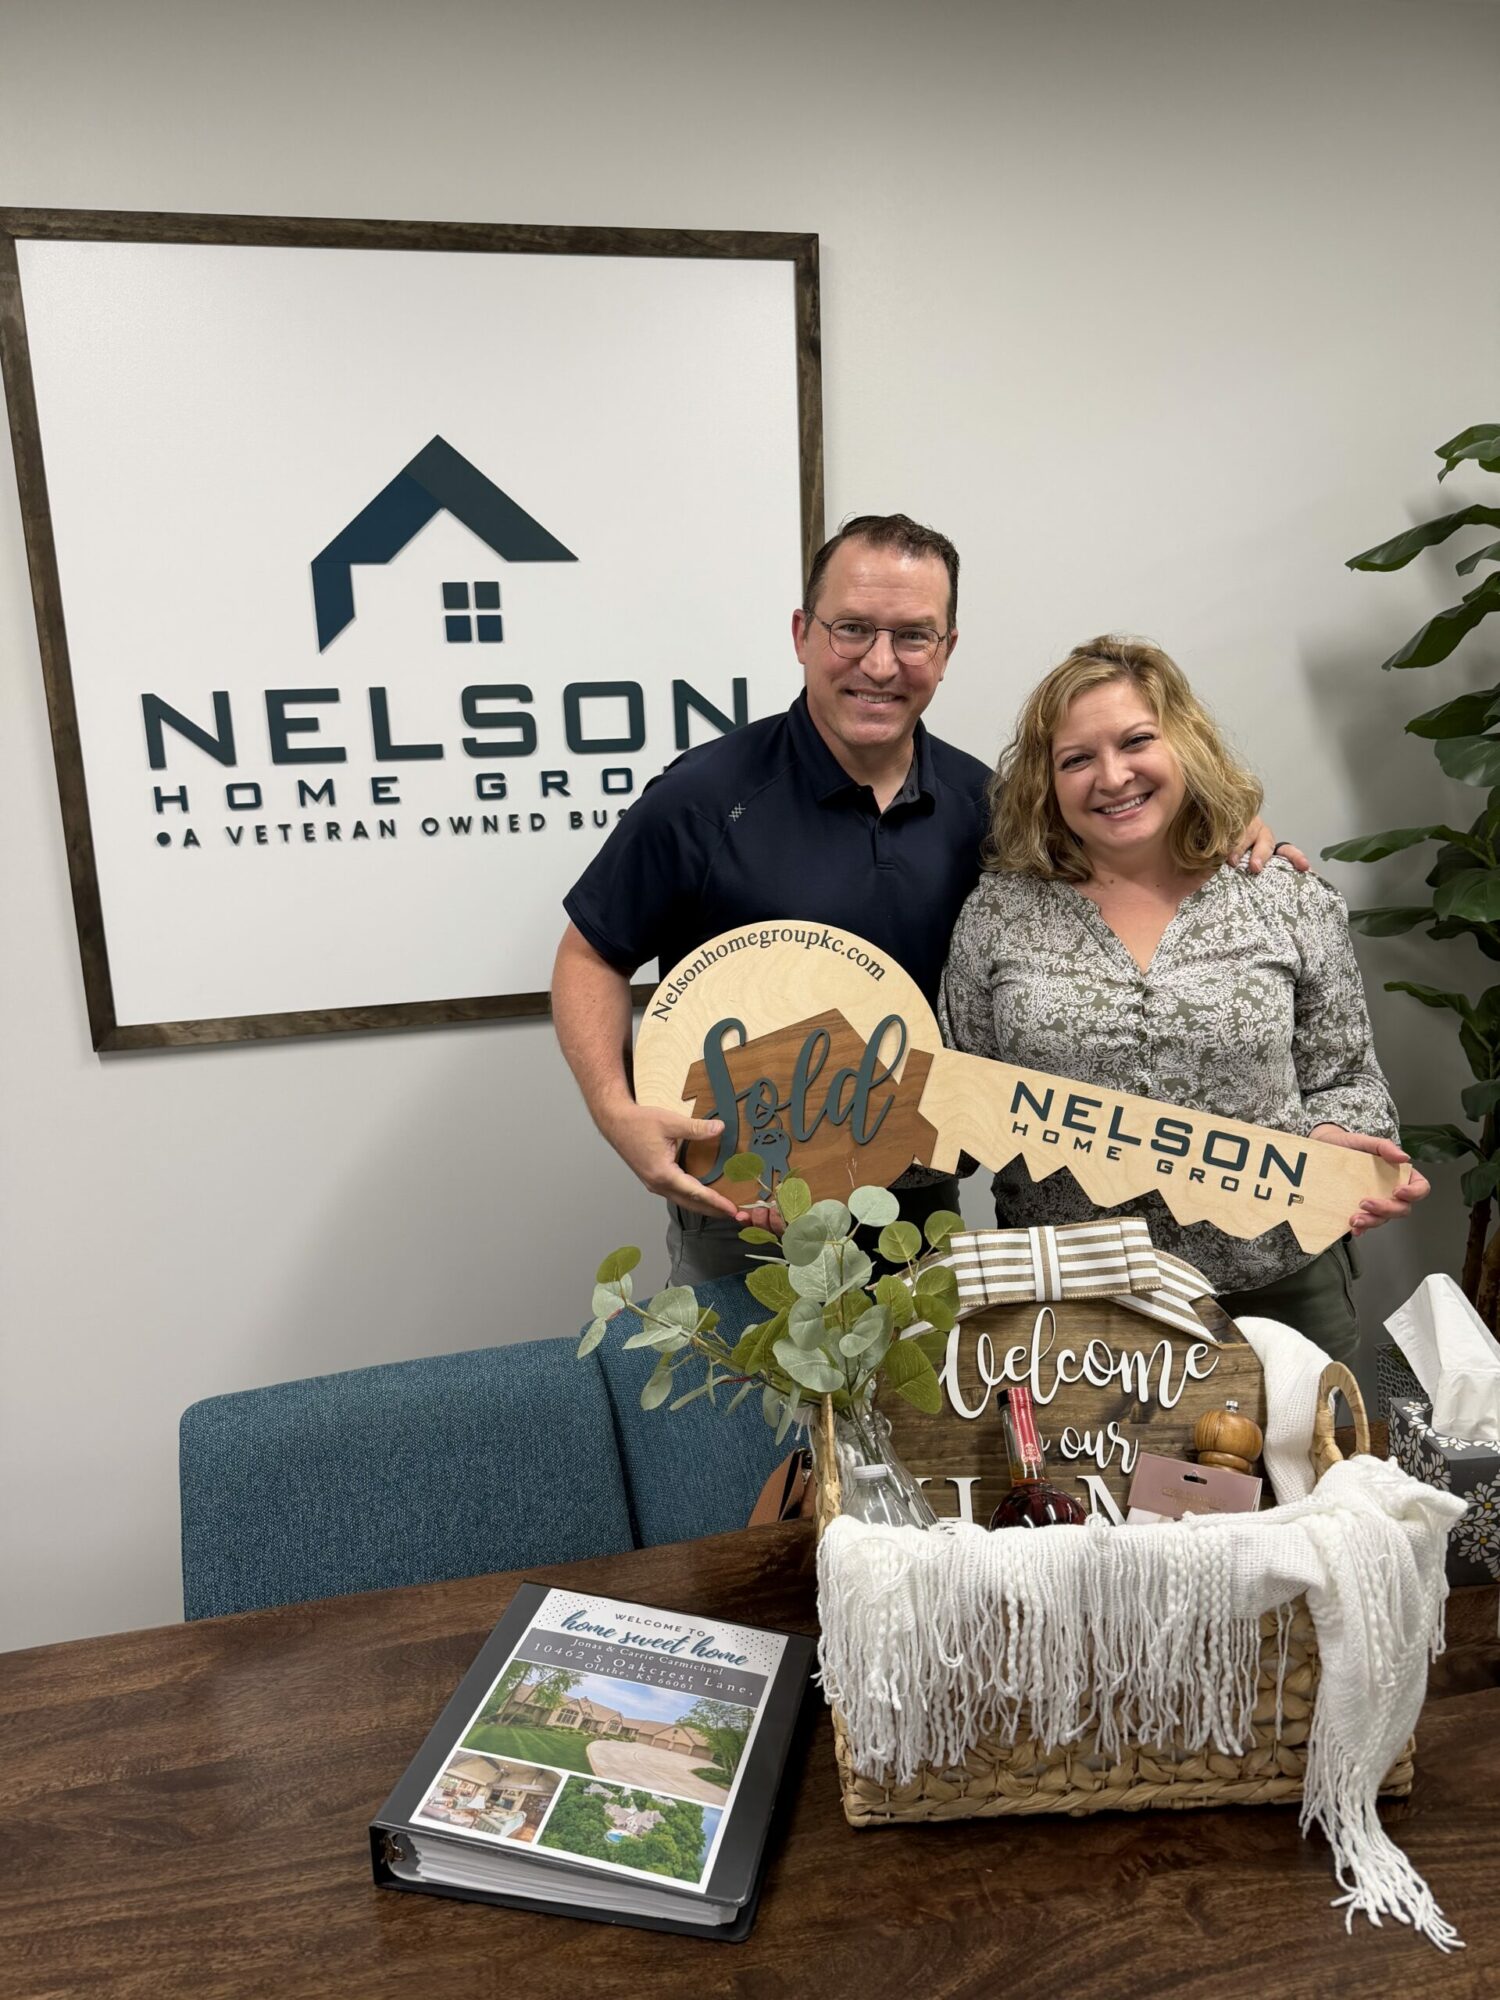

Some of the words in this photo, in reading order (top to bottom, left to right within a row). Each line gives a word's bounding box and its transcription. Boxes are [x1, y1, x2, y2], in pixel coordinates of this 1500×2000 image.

[141, 677, 749, 769] NELSON
[153, 776, 400, 814] HOME
[475, 766, 669, 801] GRO
[226, 819, 397, 847] VETERAN
[421, 812, 546, 838] OWNED
[651, 927, 886, 1022] Nelsonhomegroupkc.com
[697, 1014, 907, 1185] Sold
[1010, 1081, 1307, 1187] NELSON
[1011, 1121, 1121, 1161] HOME
[1156, 1159, 1304, 1206] GROUP
[938, 1306, 1220, 1419] Welcome
[1060, 1421, 1139, 1475] our
[560, 1609, 618, 1638] home
[618, 1630, 691, 1655] sweet
[690, 1635, 750, 1666] home
[615, 1613, 682, 1633] WELCOME
[688, 1627, 706, 1638] TO
[533, 1643, 585, 1660] 10462
[594, 1654, 604, 1664] S
[613, 1658, 694, 1683] Oakcrest
[570, 1638, 602, 1650] Jonas
[606, 1645, 616, 1653] &
[620, 1648, 655, 1661] Carrie
[659, 1656, 724, 1676] Carmichael
[636, 1672, 652, 1682] KS
[658, 1678, 694, 1691] 66061
